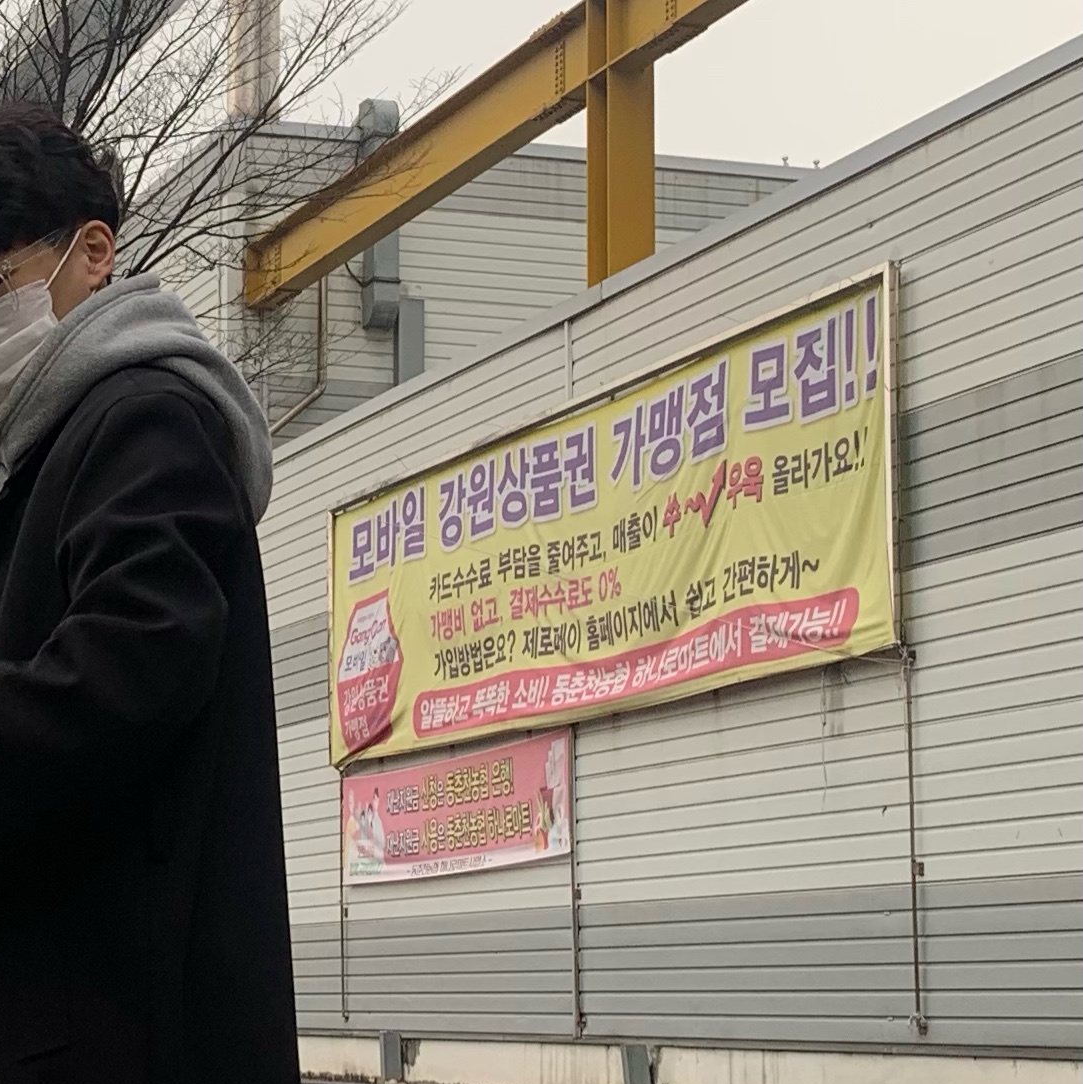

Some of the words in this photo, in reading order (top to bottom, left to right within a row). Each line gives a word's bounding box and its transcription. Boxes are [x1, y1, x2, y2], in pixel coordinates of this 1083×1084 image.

[348, 486, 425, 582] 모바일
[438, 425, 596, 548] 강원상품권
[610, 360, 729, 487] 가맹점
[744, 295, 878, 427] 모집!!
[428, 557, 493, 604] 카드수수료
[497, 543, 541, 583] 부담을
[547, 530, 607, 575] 줄여주고,
[612, 505, 659, 554] 매출이
[429, 602, 467, 643] 가맹비
[470, 596, 504, 632] 없고,
[509, 575, 593, 621] 결제수수료도
[598, 566, 622, 598] 0%
[433, 629, 517, 681] 가입방법은요?
[521, 619, 582, 660] 제로페이
[585, 589, 680, 652] 홈페이지에서
[722, 550, 820, 604] 간편하게~
[343, 673, 390, 718] 강원상품권
[344, 651, 366, 673] 모바일
[471, 679, 510, 718] 똑똑한
[512, 675, 550, 711] 소비!
[631, 616, 743, 689] 하나로마트에서
[386, 784, 420, 815] 재난지원금
[420, 774, 445, 810] 신청은
[445, 762, 490, 807] 동춘천농협
[386, 826, 420, 858] 재난지원금
[421, 818, 446, 854] 사용은
[446, 808, 488, 850] 동춘천농협
